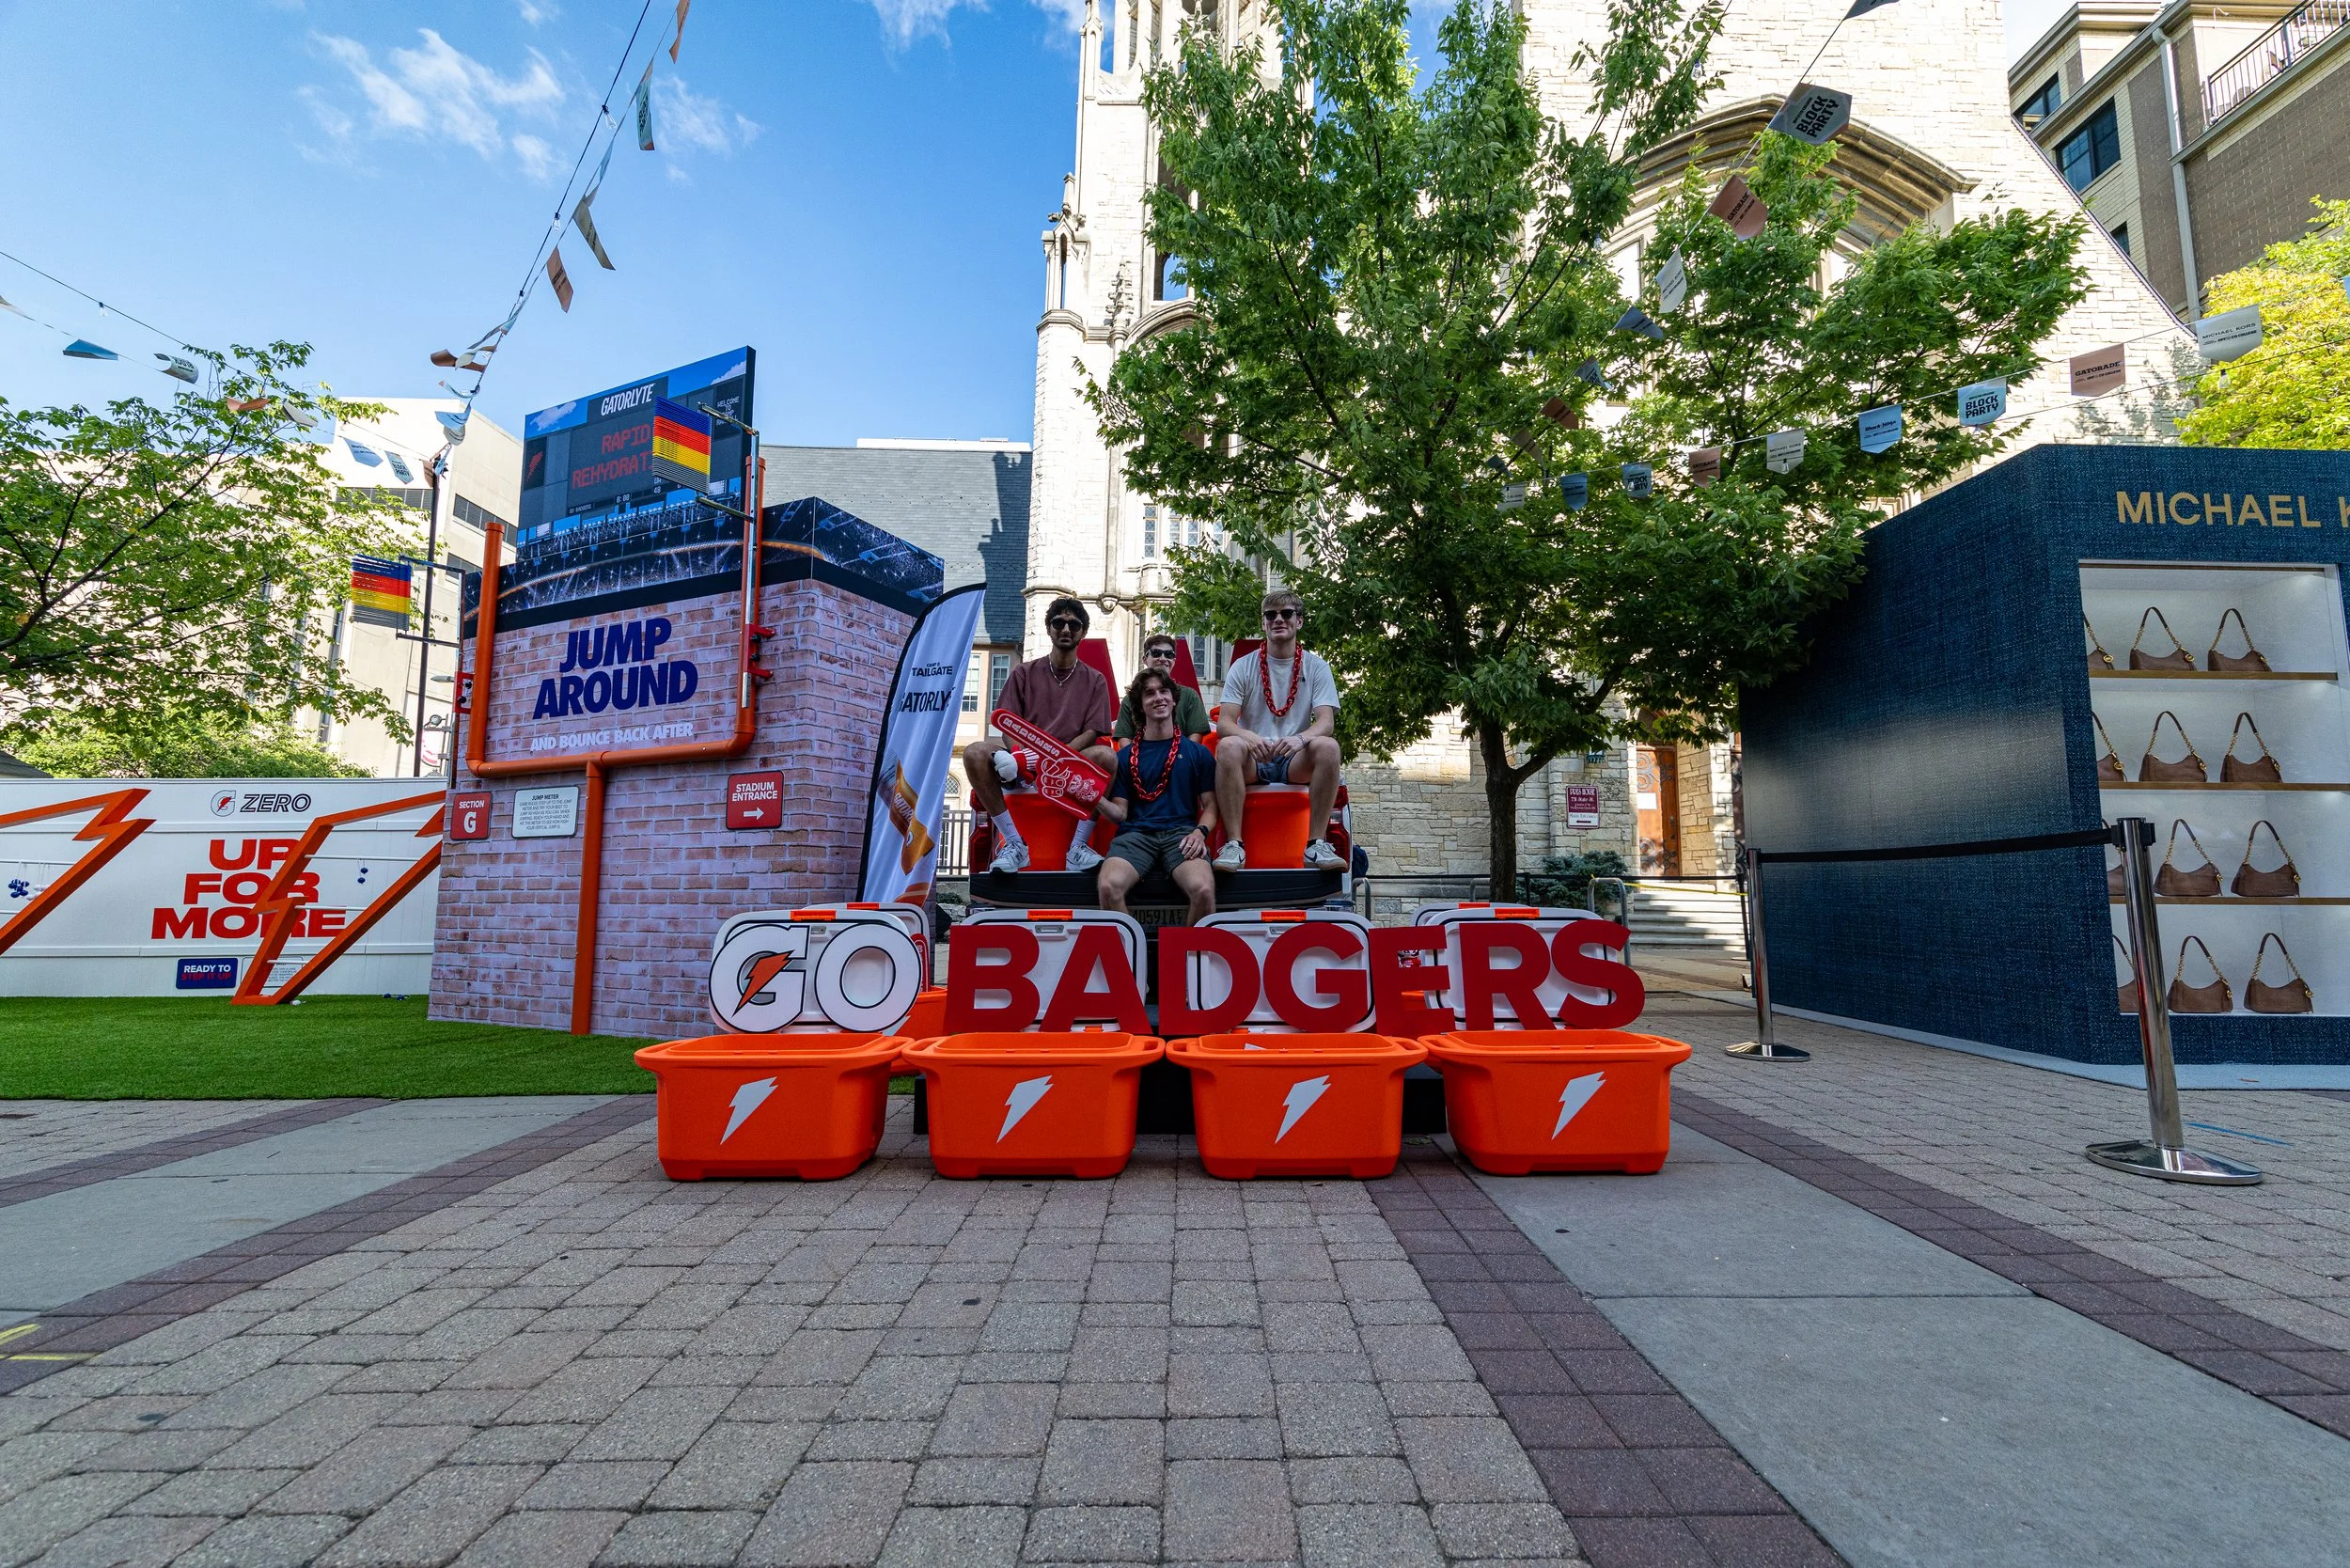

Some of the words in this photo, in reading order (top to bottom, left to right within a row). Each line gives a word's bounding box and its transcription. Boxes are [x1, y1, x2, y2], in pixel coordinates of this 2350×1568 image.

[1796, 96, 1828, 133] BLOCK
[1807, 99, 1839, 137] PARTY
[2202, 328, 2233, 339] MICHAEL
[2235, 322, 2256, 331] KORS
[2076, 361, 2121, 377] GATORADE
[601, 383, 655, 416] GATORLYTE
[1966, 395, 1998, 411] BLOCK
[1966, 402, 1998, 418] PARTY
[601, 424, 650, 454] RAPID
[2116, 491, 2322, 527] MICHAEL
[559, 617, 672, 673] JUMP
[912, 666, 953, 677] TAILGATE
[532, 660, 698, 720] AROUND
[899, 687, 955, 713] ATORLY
[531, 736, 556, 751] AND
[559, 730, 610, 748] BOUNCE
[614, 727, 650, 744] BACK
[652, 722, 694, 740] AFTER
[1002, 717, 1060, 757] BADGERS
[731, 790, 778, 802] ENTRANCE
[736, 781, 775, 792] STADIUM
[240, 793, 312, 812] ZERO
[459, 800, 485, 808] SECTION
[463, 811, 477, 834] G
[209, 839, 302, 871] UP
[183, 871, 321, 905] FOR
[183, 964, 215, 973] READY
[218, 964, 231, 973] TO
[709, 922, 922, 1033] GO
[944, 919, 1645, 1035] BADGERS
